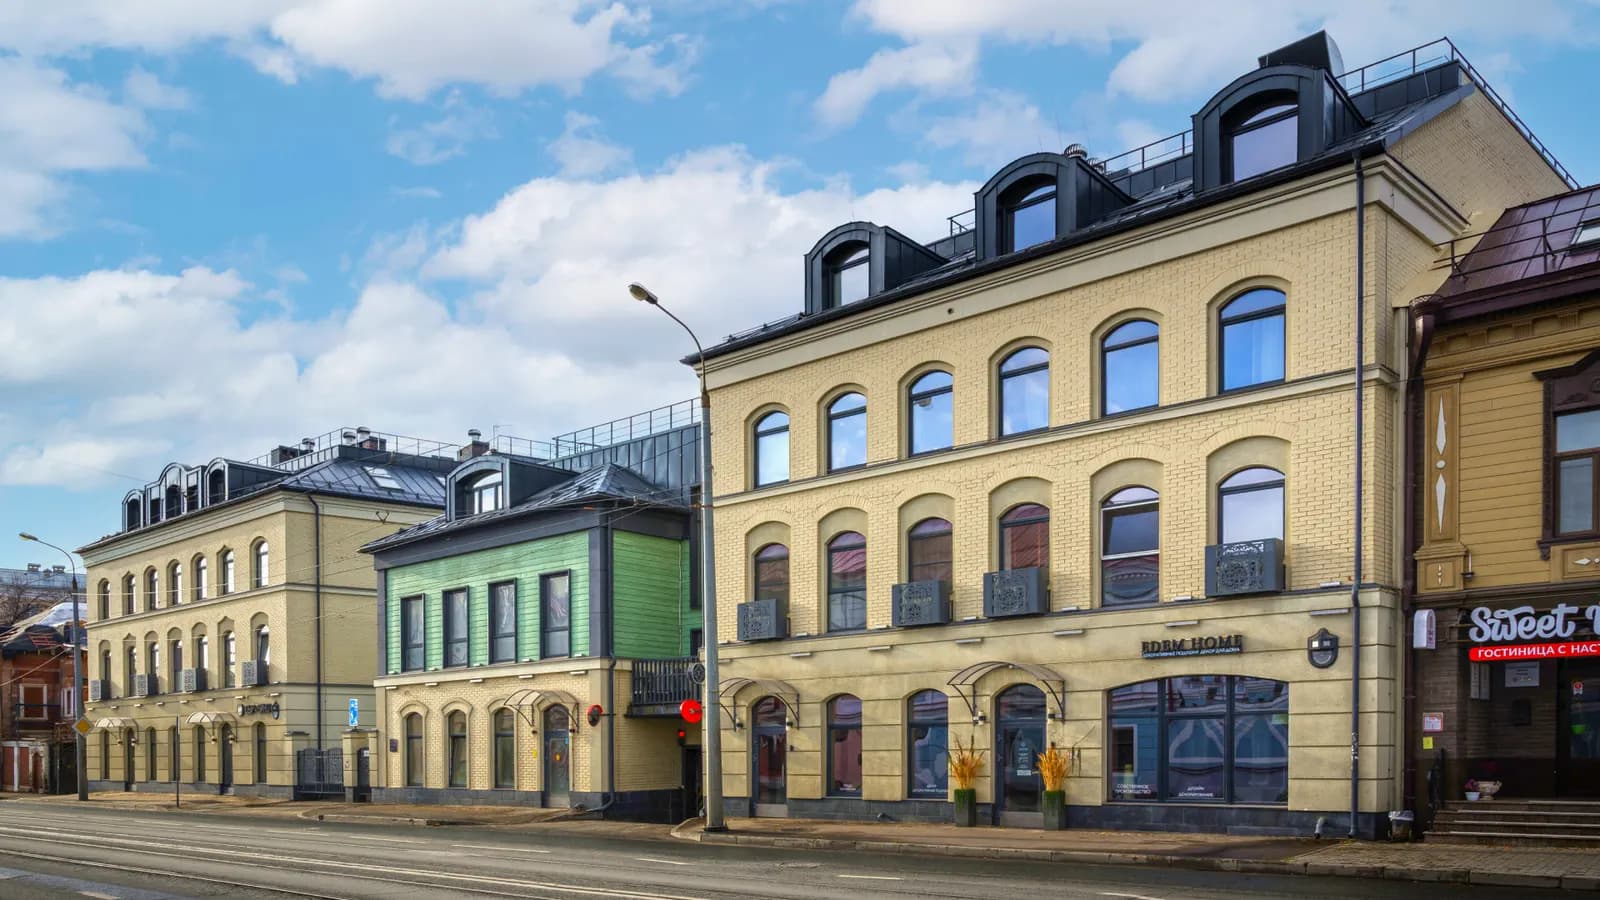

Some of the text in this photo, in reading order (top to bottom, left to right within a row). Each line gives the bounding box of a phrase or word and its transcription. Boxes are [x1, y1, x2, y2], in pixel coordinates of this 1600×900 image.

[1469, 603, 1579, 642] Sweet
[1191, 635, 1243, 650] HOME
[1478, 646, 1555, 658] ГОСТИНИЦА
[1558, 645, 1566, 654] С
